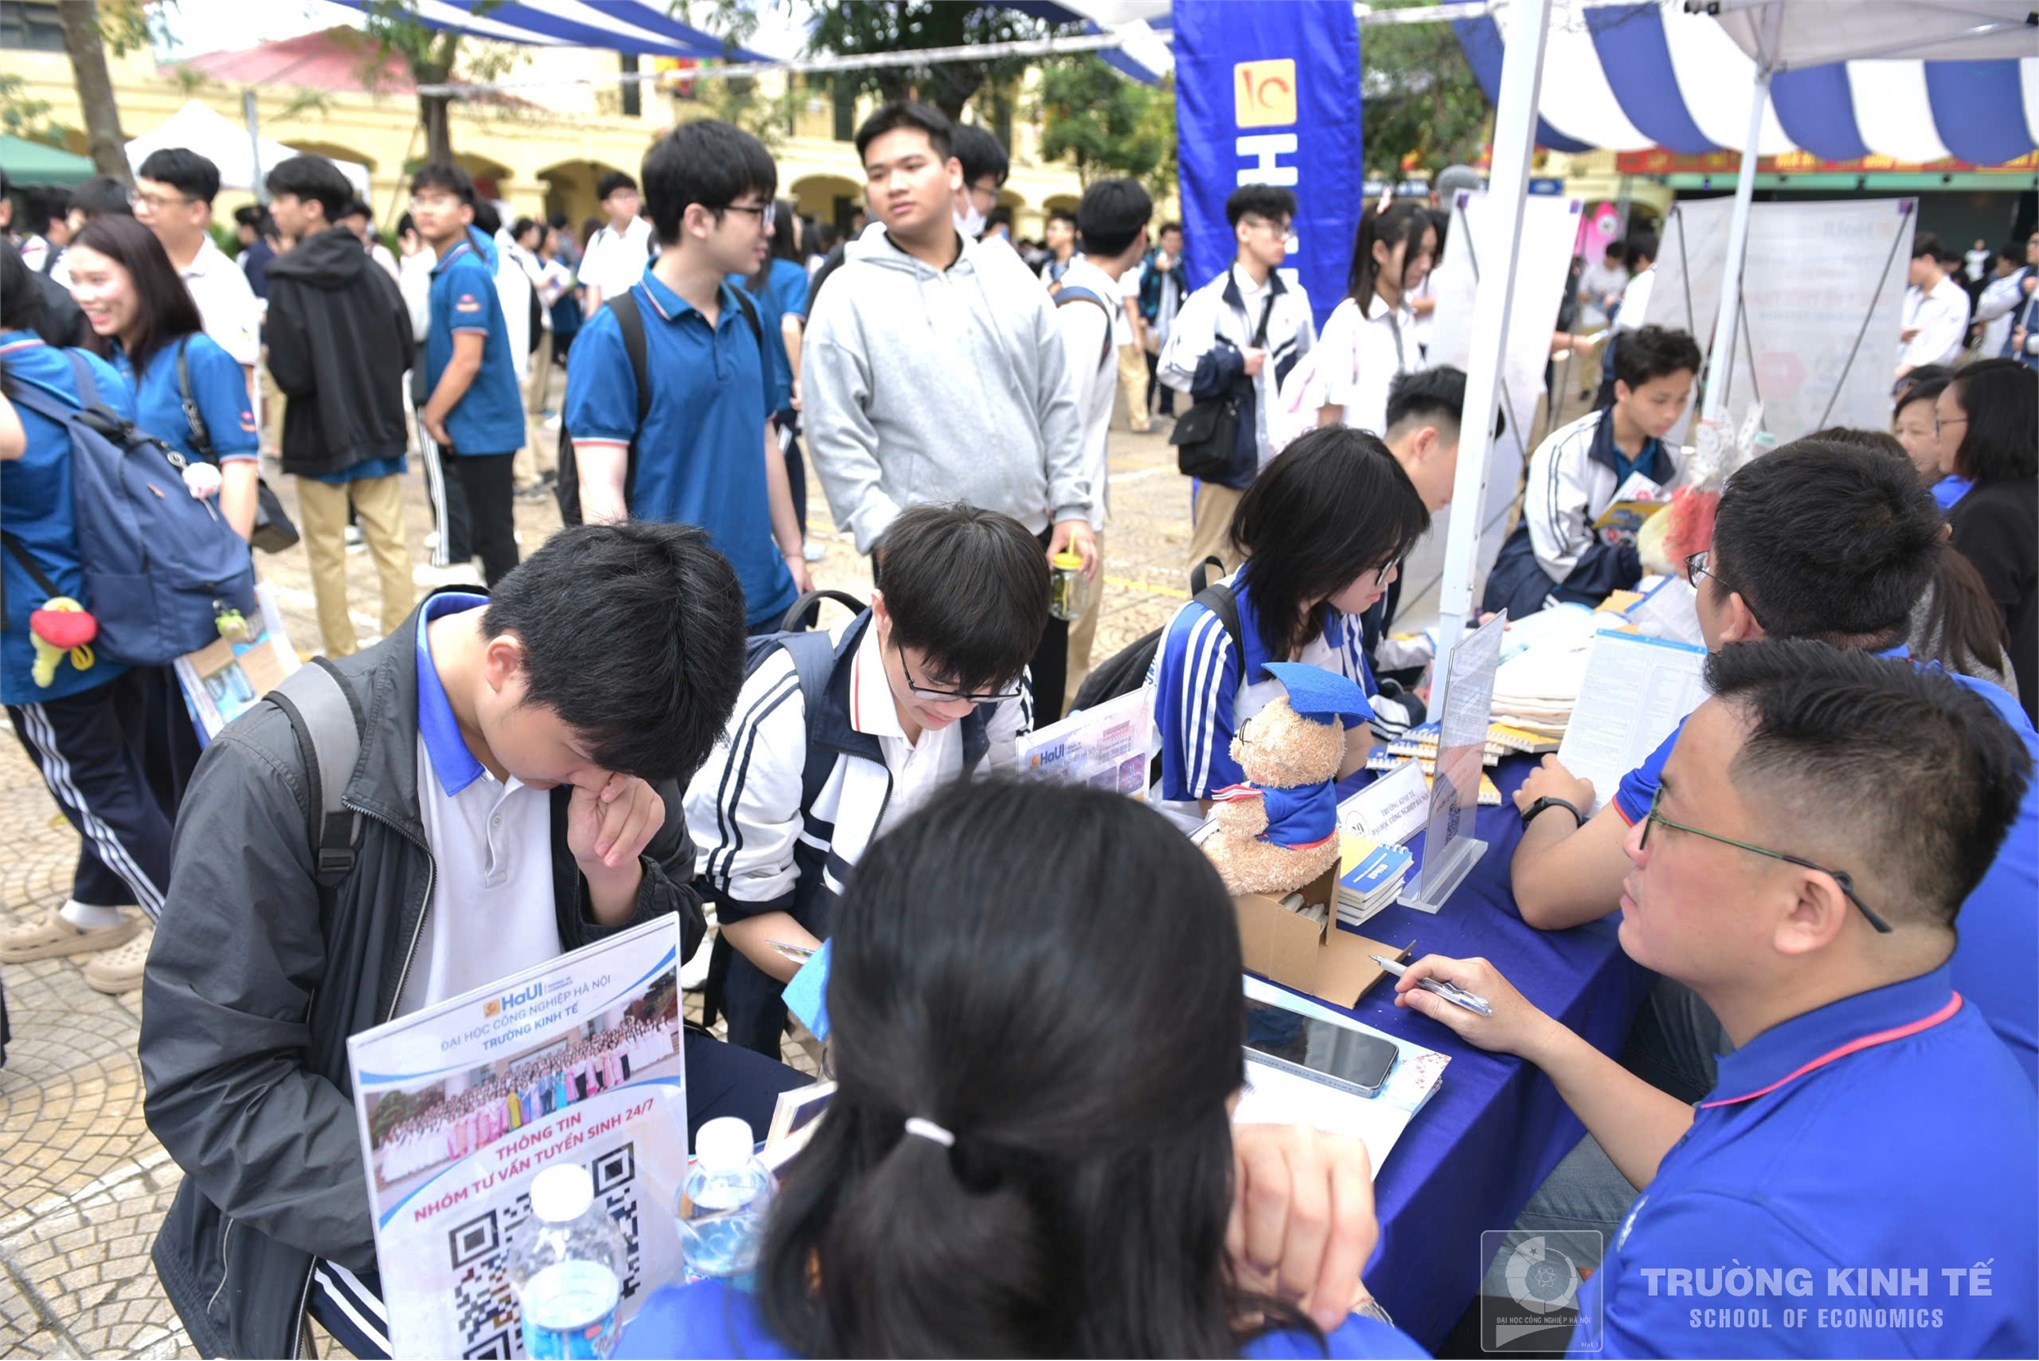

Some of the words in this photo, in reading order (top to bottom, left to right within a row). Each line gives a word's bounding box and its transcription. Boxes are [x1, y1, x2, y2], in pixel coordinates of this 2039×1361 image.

[1040, 743, 1065, 766] HaUI
[440, 1035, 461, 1052] ĐẠI
[464, 1023, 490, 1041] HỌC
[493, 1010, 526, 1031] CÔNG
[529, 991, 571, 1015] NGHIỆP
[573, 983, 590, 1000] HÀ
[592, 974, 611, 990] NỘI
[501, 982, 543, 1011] HaUI
[482, 1025, 531, 1051] TRƯỜNG
[534, 1011, 561, 1030] KINH
[564, 1002, 579, 1017] TẾ
[413, 1186, 468, 1222] NHÓM
[472, 1175, 496, 1194] TƯ
[498, 1158, 530, 1181] VẤN
[534, 1132, 584, 1164] TUYỂN
[587, 1114, 622, 1140] SINH
[625, 1098, 654, 1121] 24/7
[496, 1126, 553, 1161] THÔNG
[556, 1111, 582, 1133] TIN
